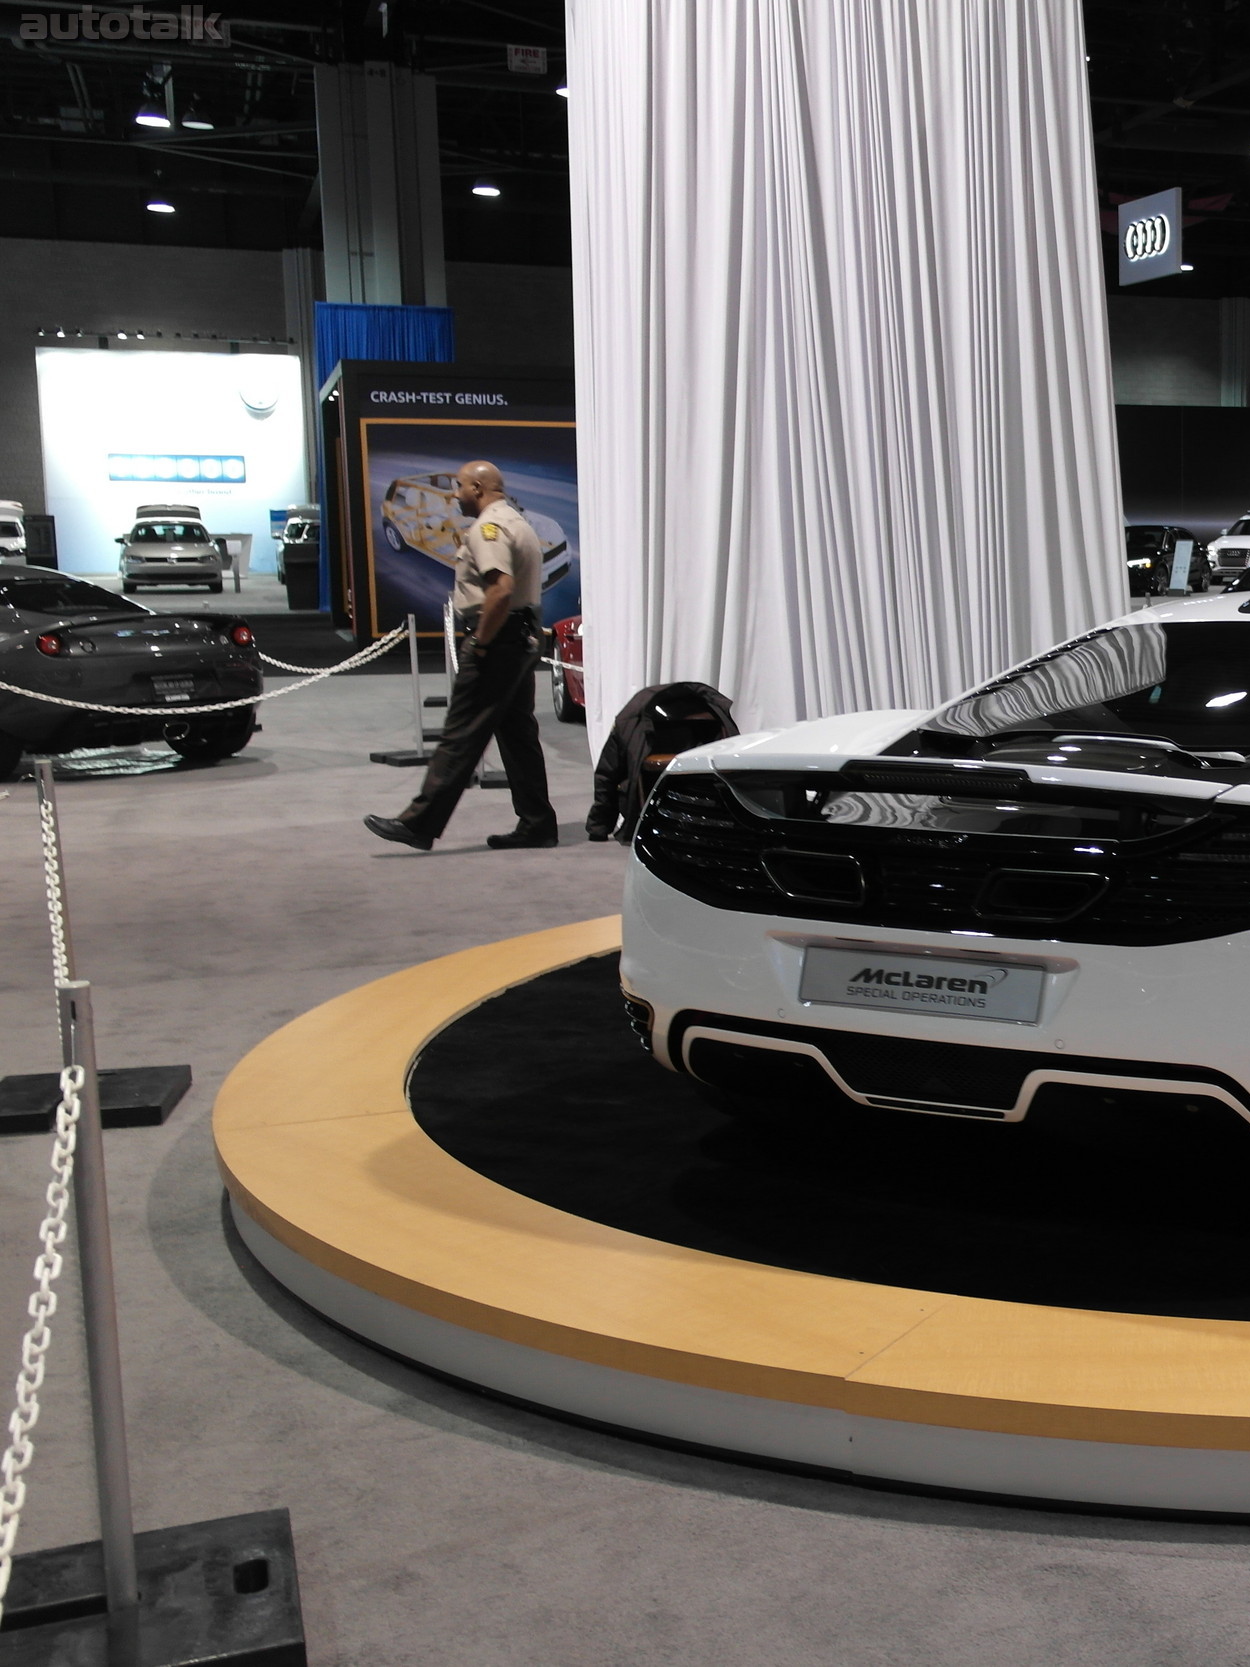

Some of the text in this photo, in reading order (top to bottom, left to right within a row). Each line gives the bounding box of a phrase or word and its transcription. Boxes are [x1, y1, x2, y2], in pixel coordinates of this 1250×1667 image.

[514, 47, 539, 57] FIRE
[370, 390, 508, 406] CRASH-TEST GENIUS.
[849, 967, 988, 994] McLaren
[847, 985, 987, 1009] SPECIAL OPERATIONS
